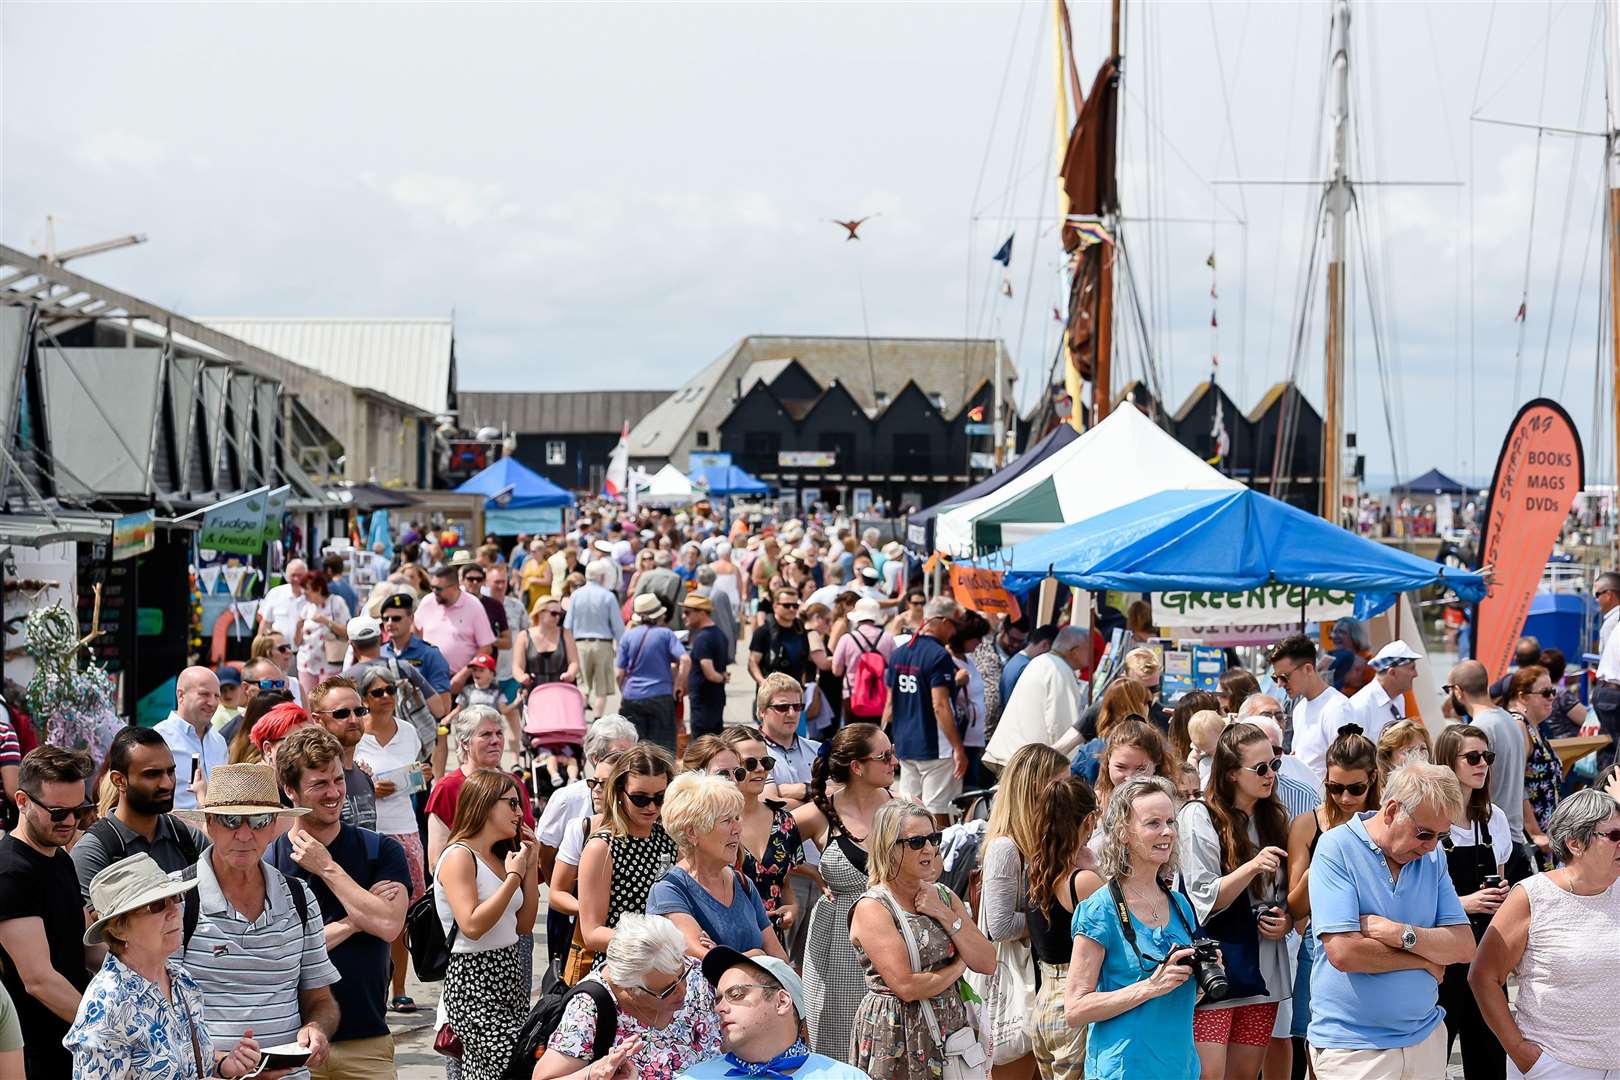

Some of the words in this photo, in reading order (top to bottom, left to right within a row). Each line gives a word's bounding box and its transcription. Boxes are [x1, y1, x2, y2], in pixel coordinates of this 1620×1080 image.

[1528, 451, 1572, 467] BOOKS
[1527, 475, 1565, 490] MAGS
[1526, 497, 1559, 512] DVDs
[210, 515, 257, 533] Fudge
[205, 533, 214, 543] &
[218, 533, 257, 547] treats
[1160, 584, 1354, 614] GREENPEACE
[898, 673, 918, 694] 96
[1119, 902, 1129, 923] Nikon
